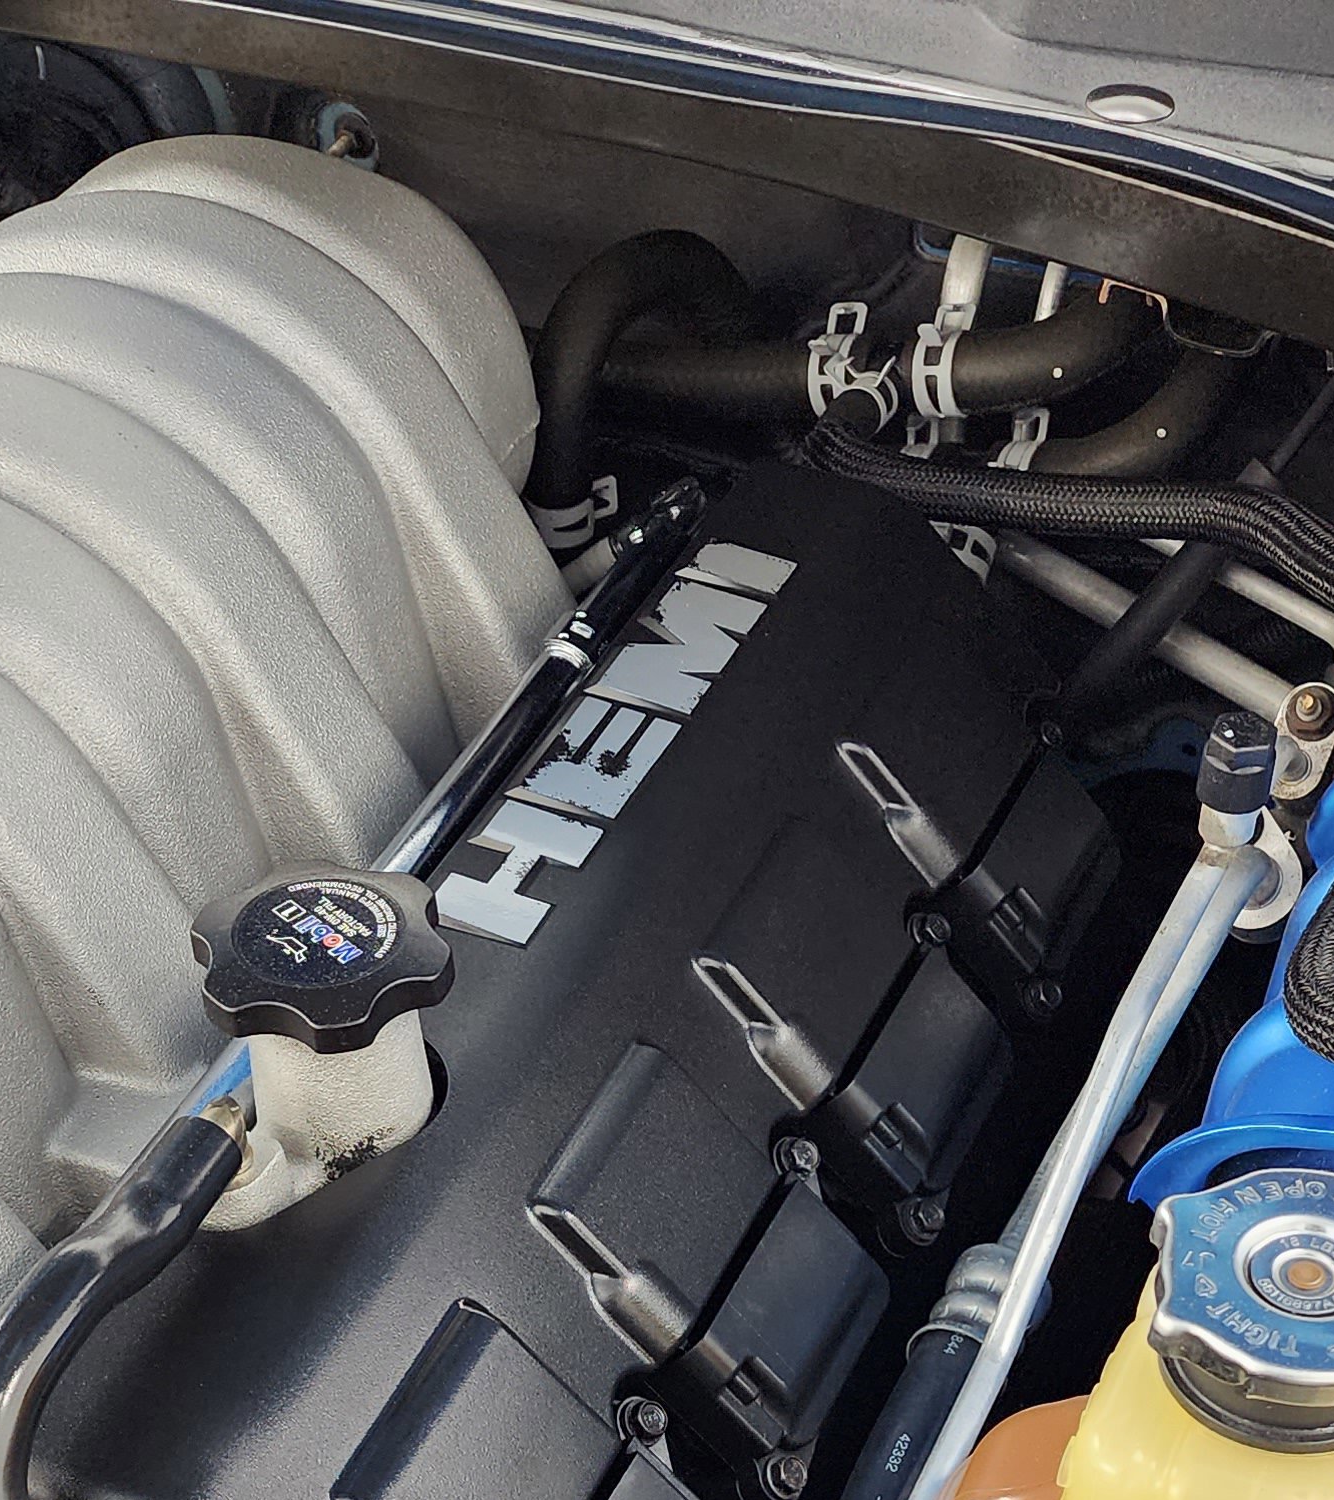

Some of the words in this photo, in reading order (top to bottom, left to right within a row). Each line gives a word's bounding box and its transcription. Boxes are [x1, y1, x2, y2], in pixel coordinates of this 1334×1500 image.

[435, 541, 799, 947] HEMI
[287, 881, 365, 893] RECOMMENDED
[319, 887, 361, 900] MANUAL
[365, 888, 379, 900] OIL
[317, 896, 338, 911] FILL
[335, 908, 373, 937] FACTORY
[337, 923, 357, 937] SAE
[292, 914, 364, 965] Mobil
[1234, 1177, 1327, 1206] OPEN
[1190, 1198, 1239, 1244] HOT
[1205, 1300, 1301, 1357] TIGHT
[884, 1432, 912, 1474] 42332
